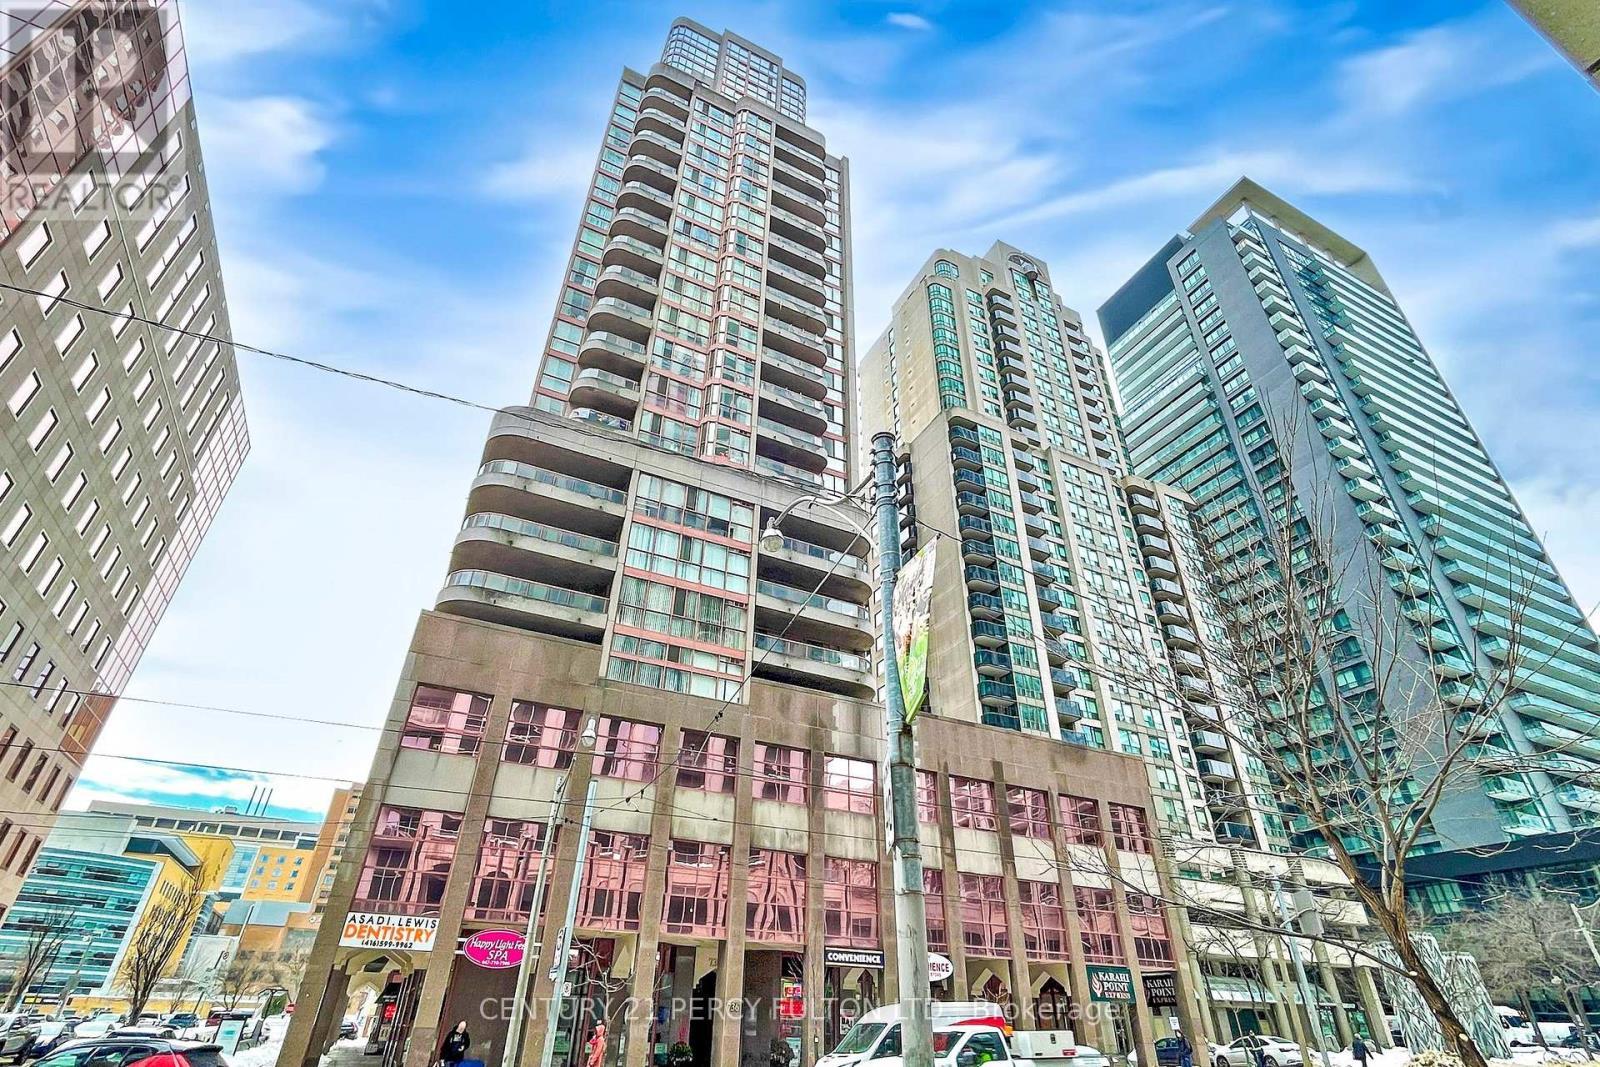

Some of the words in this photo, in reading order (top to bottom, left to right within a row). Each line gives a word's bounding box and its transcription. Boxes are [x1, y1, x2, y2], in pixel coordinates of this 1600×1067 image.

[343, 923, 435, 943] DENTISTRY
[469, 937, 496, 950] Happy
[486, 950, 509, 960] SPA
[827, 952, 881, 964] CONVENIENCE
[1097, 972, 1130, 983] KARAHI
[1103, 981, 1129, 992] POINT
